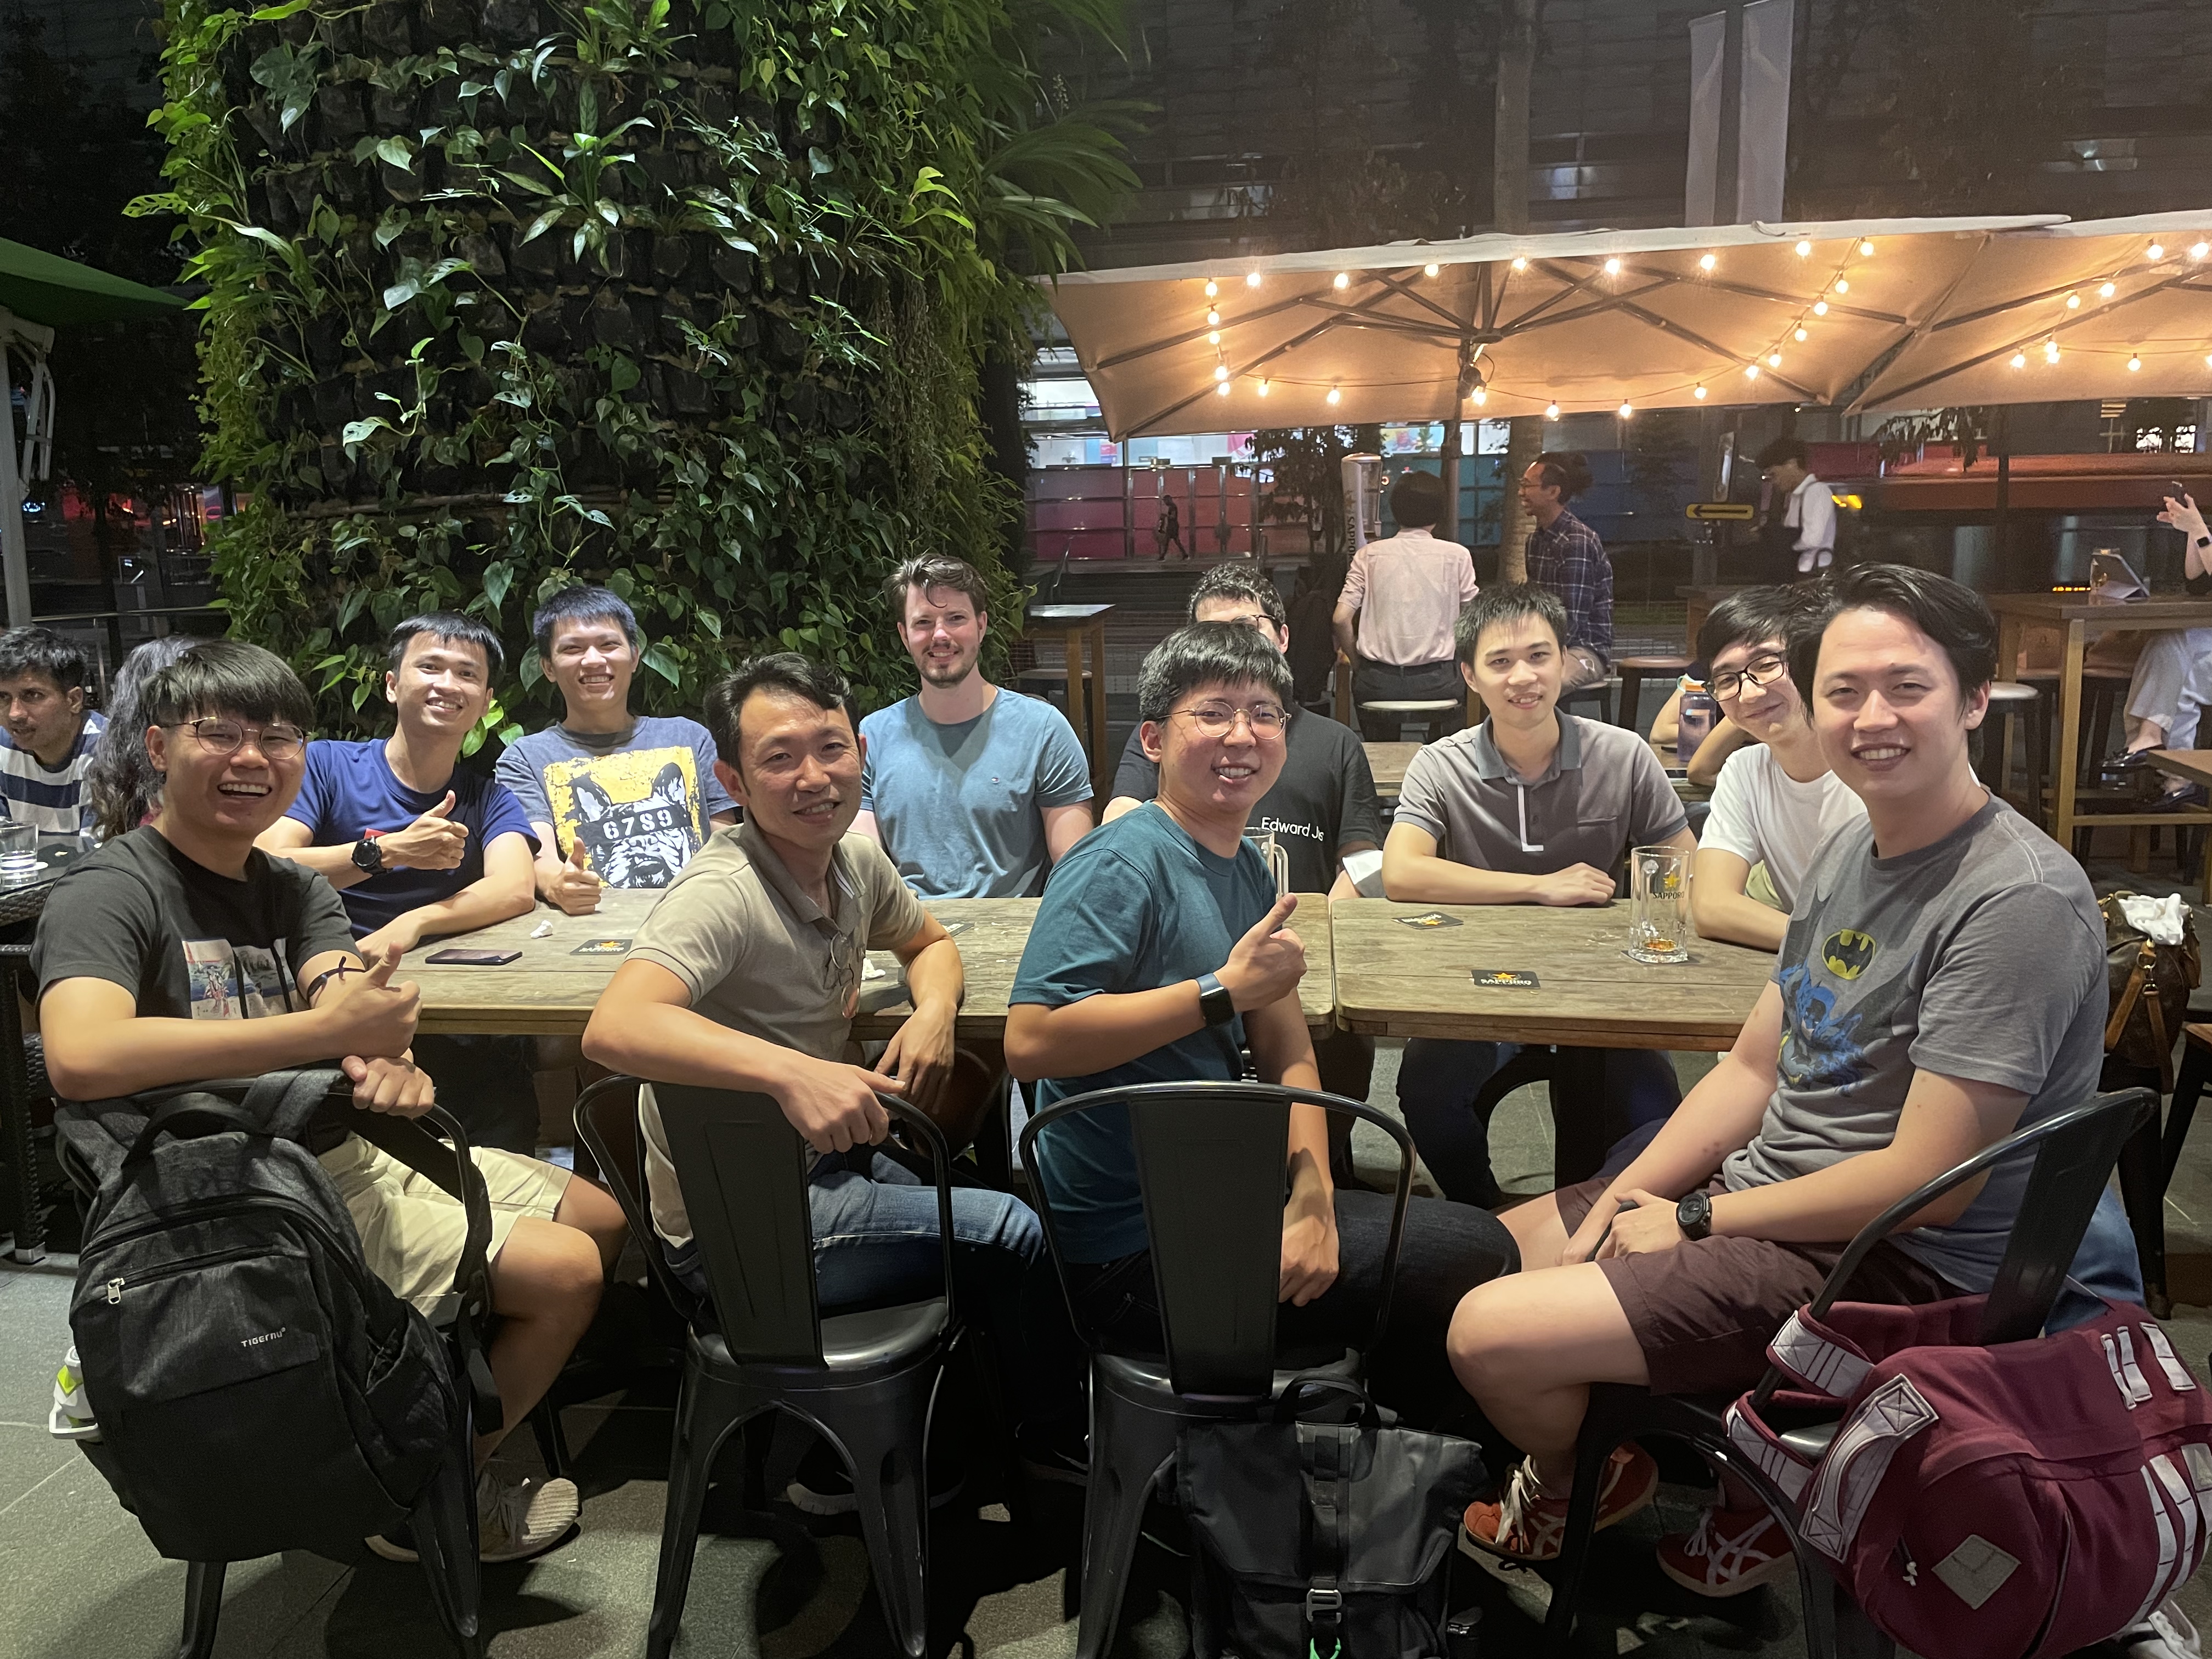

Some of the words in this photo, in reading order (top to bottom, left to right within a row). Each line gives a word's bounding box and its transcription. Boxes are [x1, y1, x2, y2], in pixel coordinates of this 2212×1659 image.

[1347, 516, 1356, 566] SAPPOR
[1261, 816, 1311, 837] Edward
[1652, 891, 1685, 899] SAPPORO
